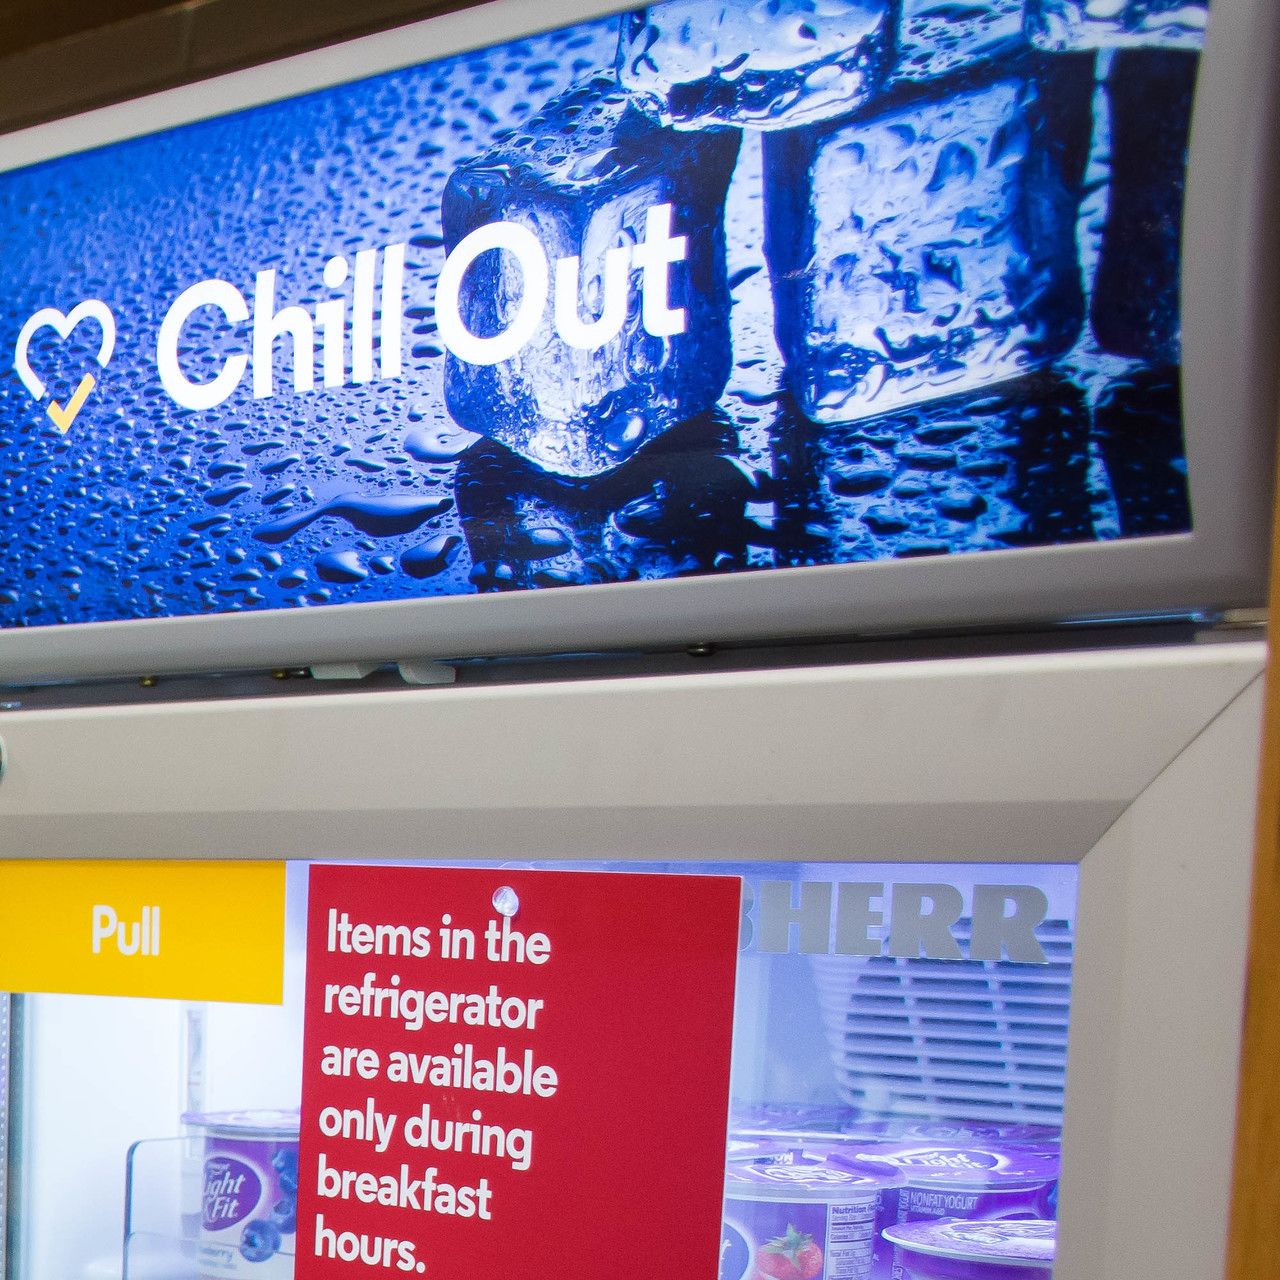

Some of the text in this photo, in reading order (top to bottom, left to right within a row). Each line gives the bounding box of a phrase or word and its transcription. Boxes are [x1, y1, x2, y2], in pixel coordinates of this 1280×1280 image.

[156, 202, 686, 411] Chill Out
[92, 905, 161, 957] Pull
[328, 909, 551, 964] Items in the
[740, 880, 1050, 964] HERR
[325, 974, 543, 1030] refrigerator
[321, 1043, 558, 1097] are available
[319, 1098, 532, 1170] only during
[317, 1154, 492, 1220] breakfast
[315, 1214, 425, 1273] hours.
